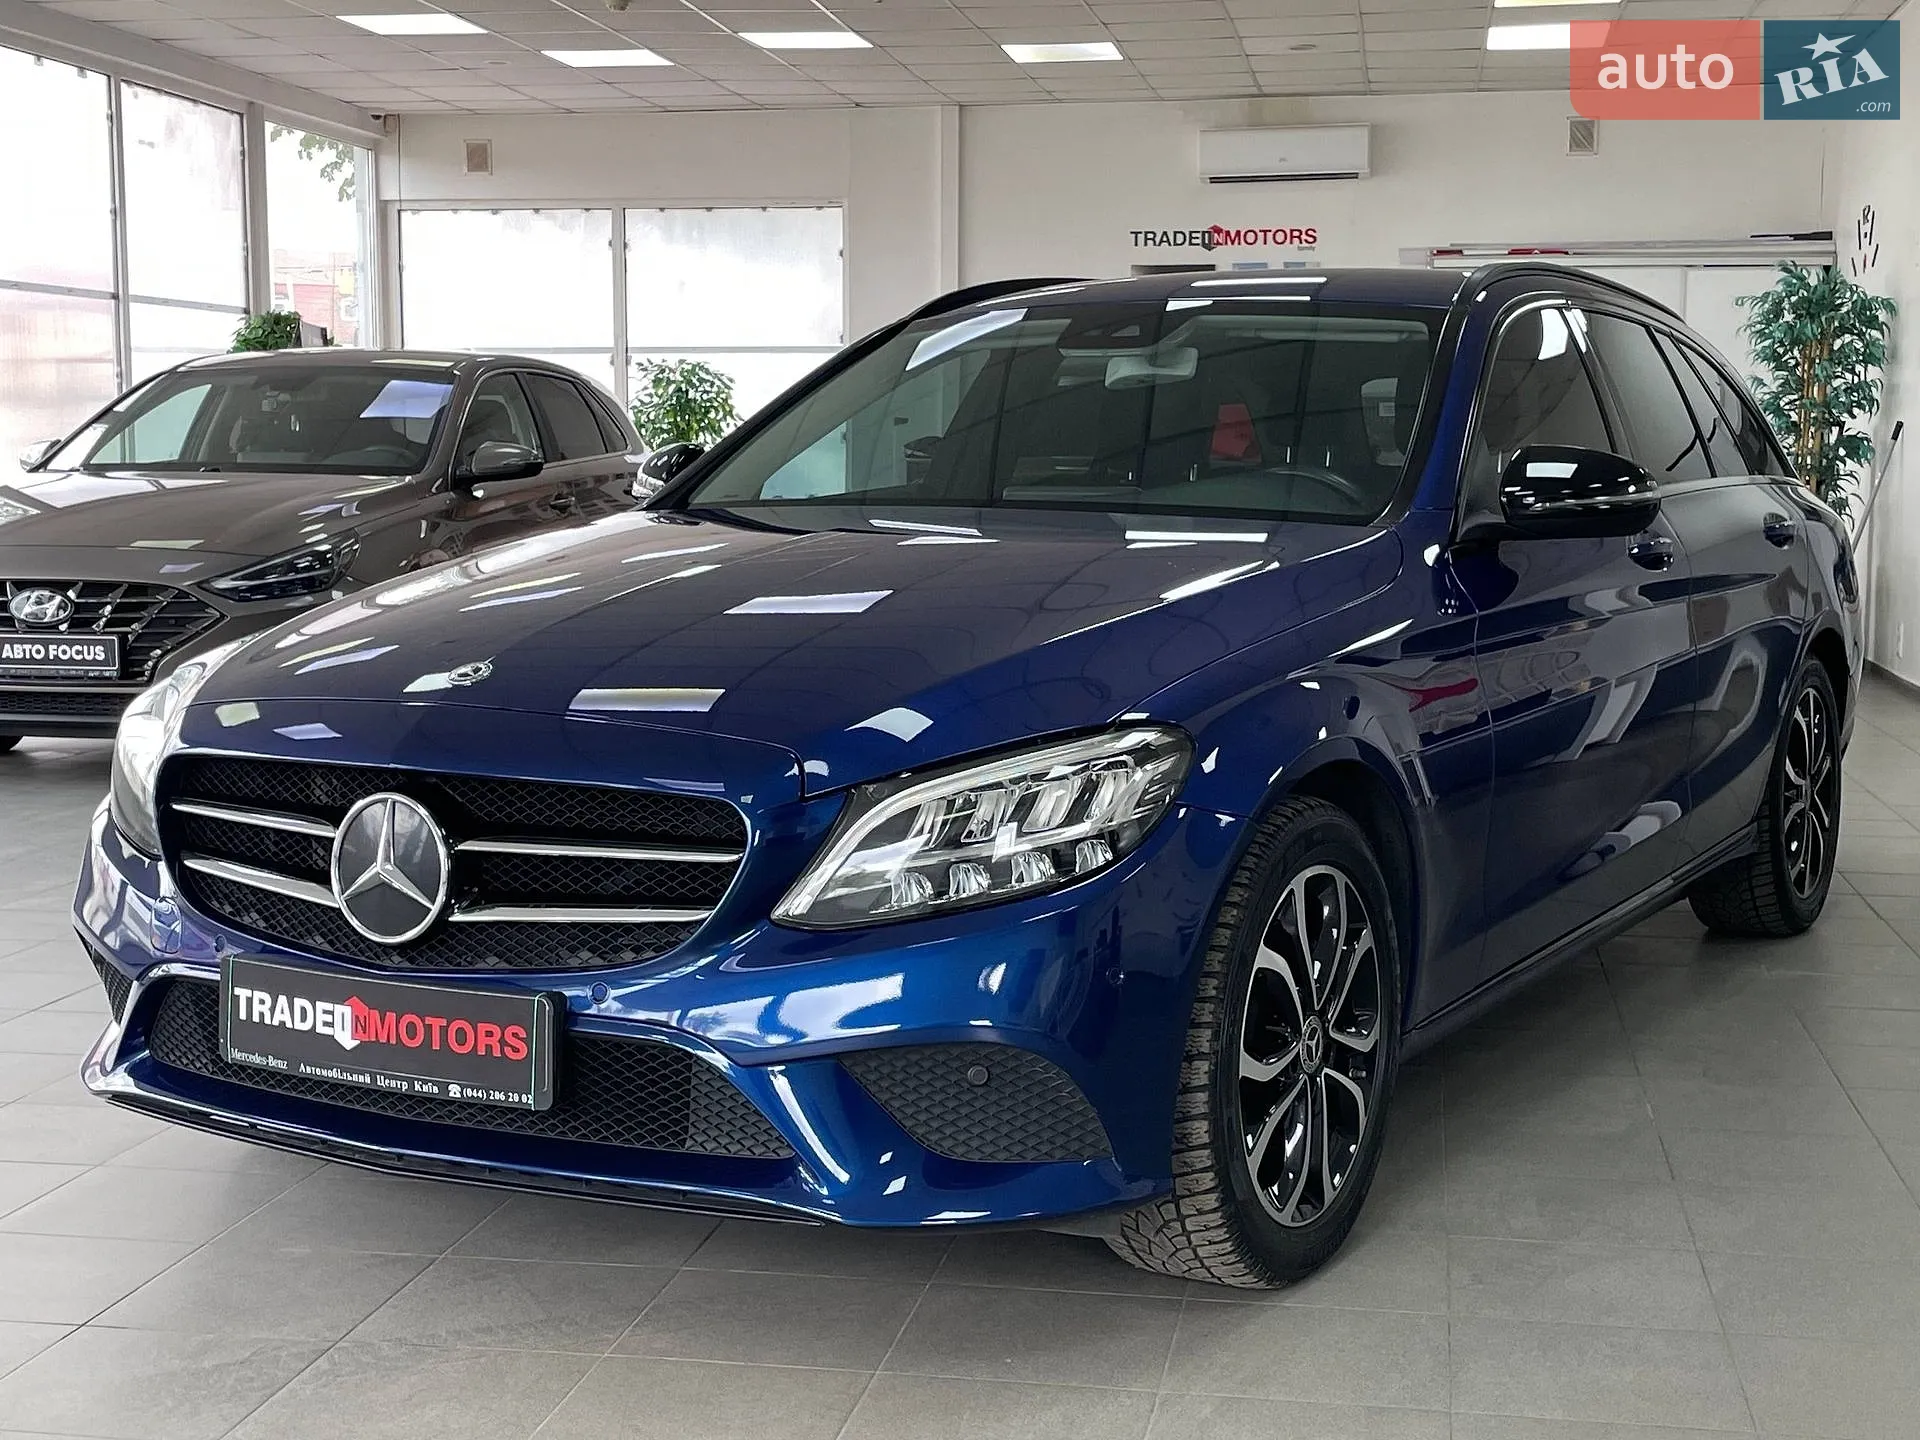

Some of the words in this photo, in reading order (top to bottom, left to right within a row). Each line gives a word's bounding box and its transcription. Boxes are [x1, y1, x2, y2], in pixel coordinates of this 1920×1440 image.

[2, 643, 45, 660] АВТО
[48, 644, 106, 661] FOCUS
[231, 1047, 288, 1070] Mercedes-Benz
[299, 1062, 371, 1084] Автомобільний
[376, 1074, 408, 1092] Центр
[414, 1080, 439, 1094] Київ
[462, 1087, 487, 1100] (044)
[508, 1092, 519, 1103] 20
